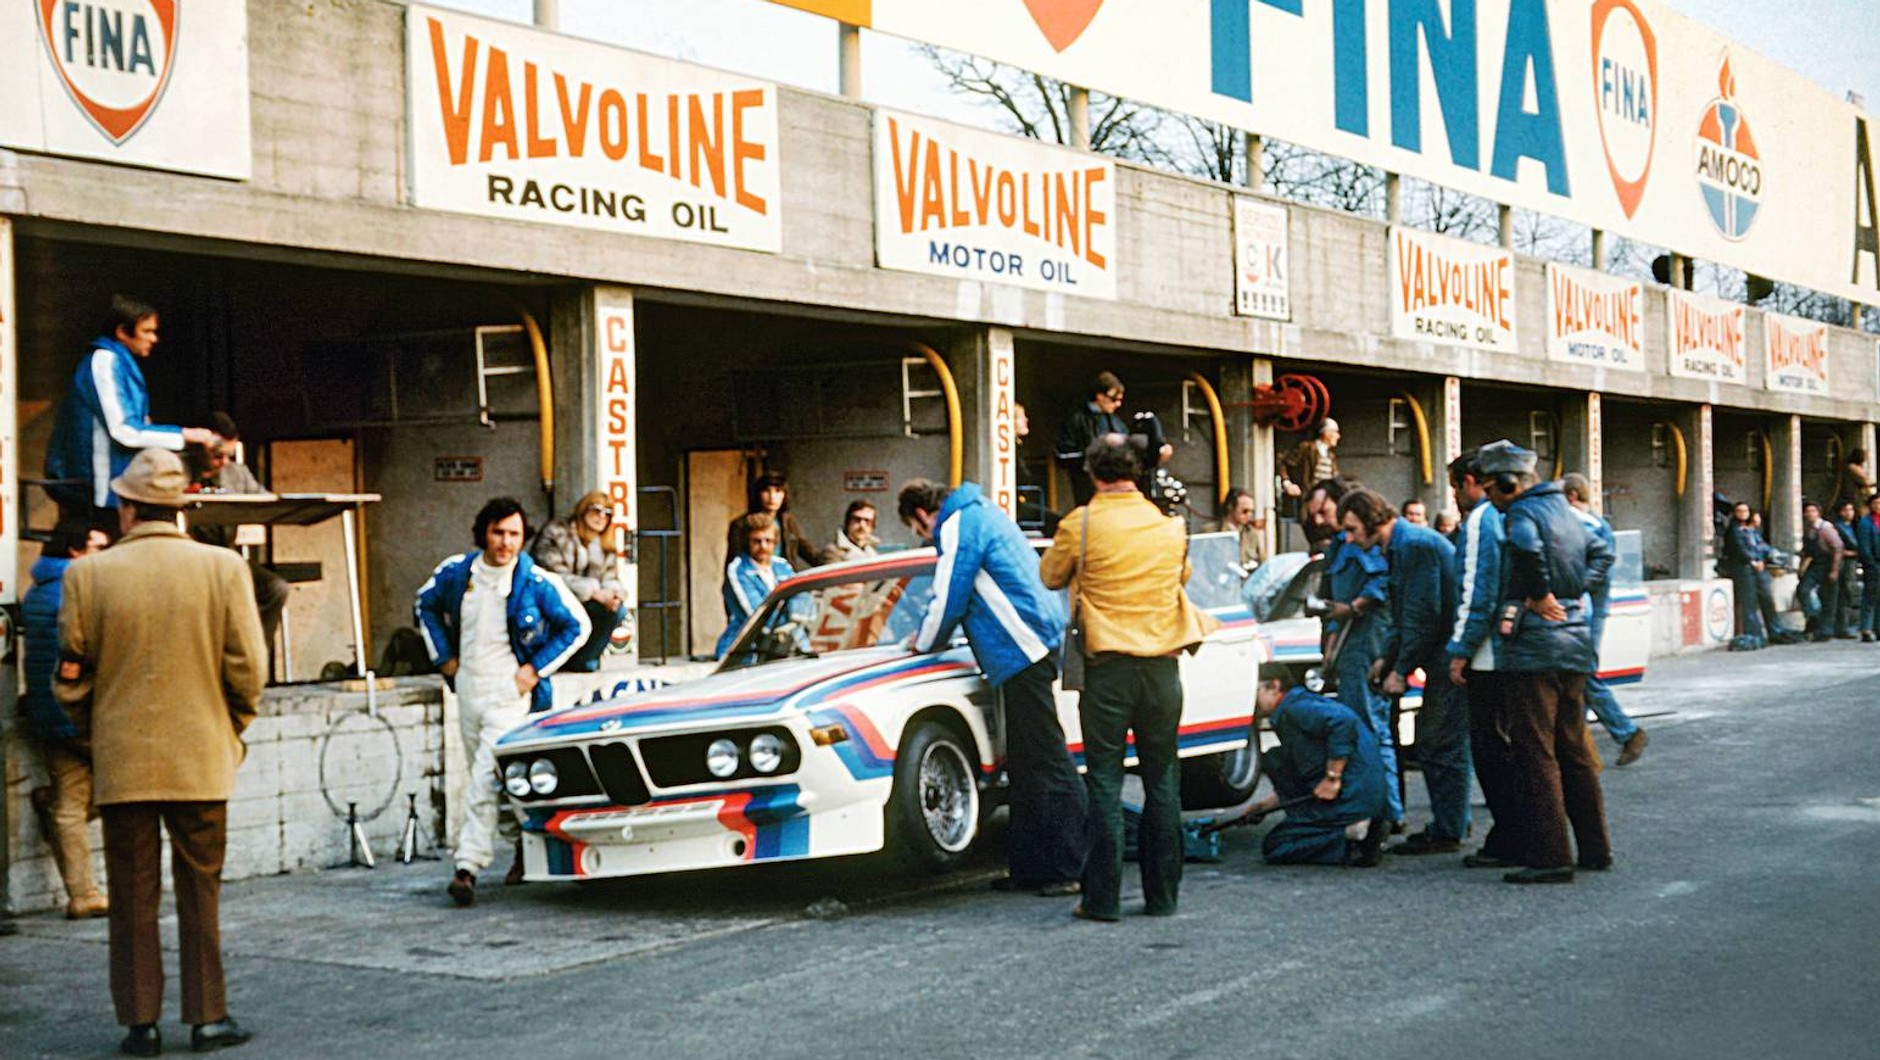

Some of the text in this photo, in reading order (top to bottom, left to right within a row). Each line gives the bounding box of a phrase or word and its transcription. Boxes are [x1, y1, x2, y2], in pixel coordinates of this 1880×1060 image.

[63, 1, 156, 76] FINA
[427, 16, 767, 216] VALVOLINE
[1602, 56, 1650, 128] FINA
[487, 173, 729, 233] RACING OIL
[888, 116, 1106, 270] VALVOLINE
[929, 240, 1078, 285] MOTOR OIL
[1397, 231, 1510, 332] VALVOLINE
[1415, 316, 1497, 344] RACING OIL
[1552, 266, 1639, 350] VALVOLINE
[1673, 292, 1743, 367] VALVOLINE
[1568, 342, 1606, 360] MOTOR
